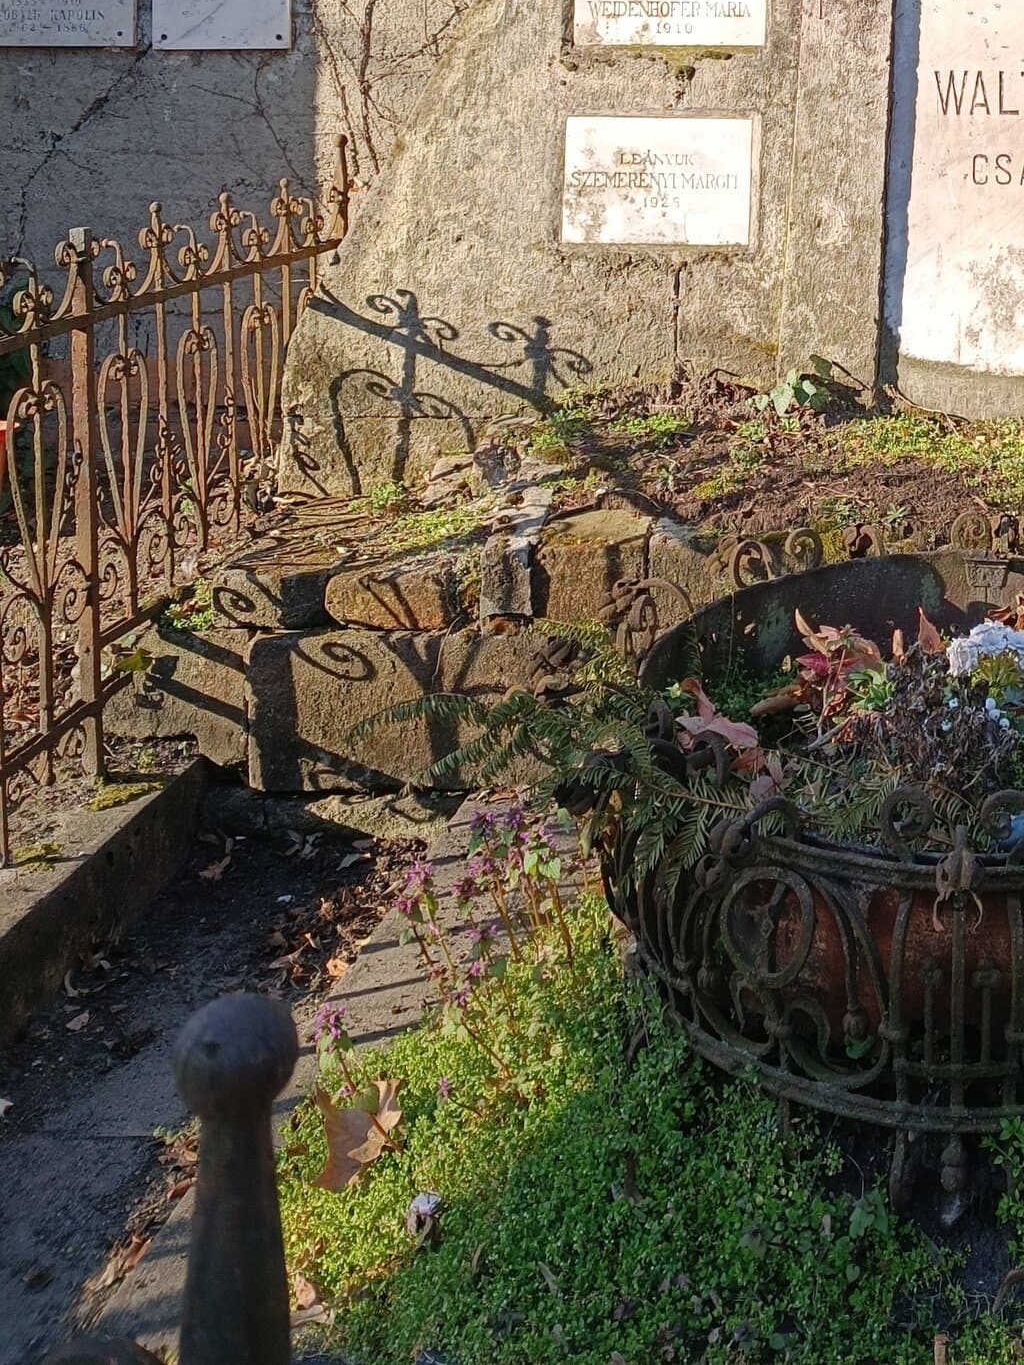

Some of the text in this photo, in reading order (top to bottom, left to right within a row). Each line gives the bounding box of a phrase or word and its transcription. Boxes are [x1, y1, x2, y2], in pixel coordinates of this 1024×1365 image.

[587, 0, 701, 18] WEIDENHOFER
[656, 22, 693, 35] 1910
[619, 150, 696, 166] LEÁNYUK
[571, 169, 738, 190] SZEMERÉNYI MARGIT
[642, 196, 681, 209] 1925
